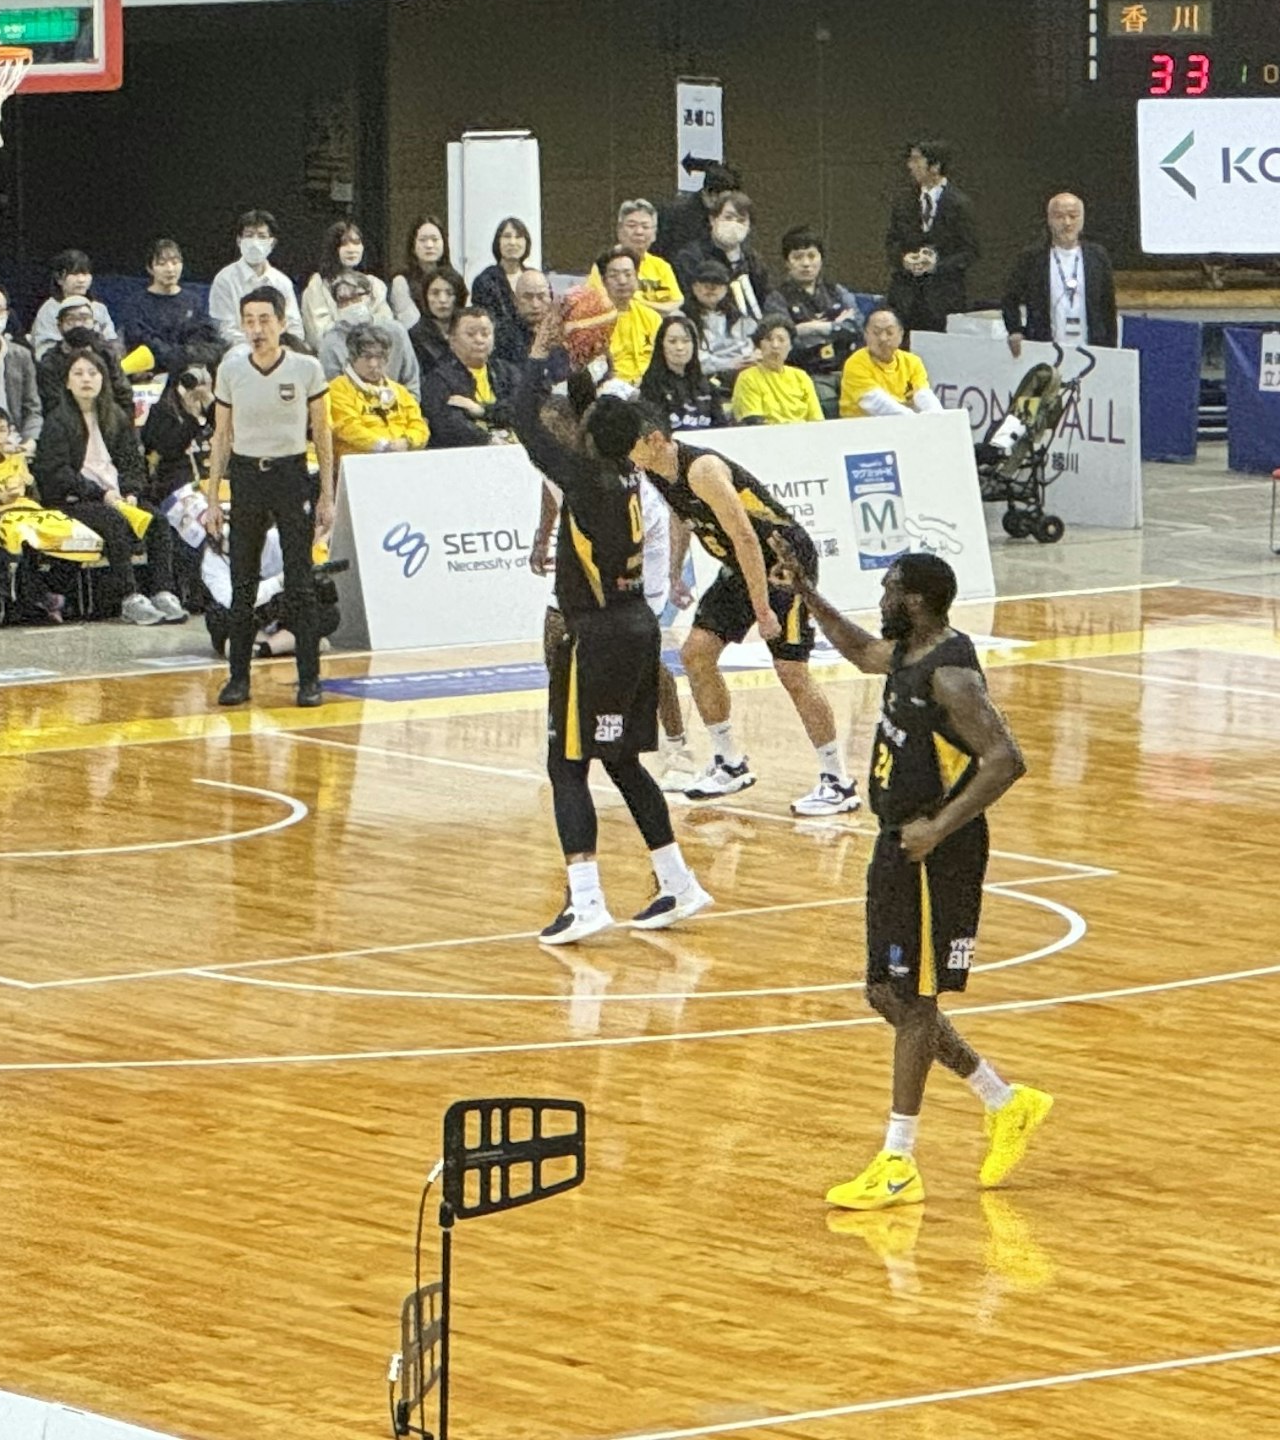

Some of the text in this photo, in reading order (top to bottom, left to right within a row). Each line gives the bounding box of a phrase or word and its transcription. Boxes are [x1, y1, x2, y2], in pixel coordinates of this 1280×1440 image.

[1120, 3, 1200, 34] 香川
[1148, 53, 1211, 95] 33
[860, 499, 898, 534] M
